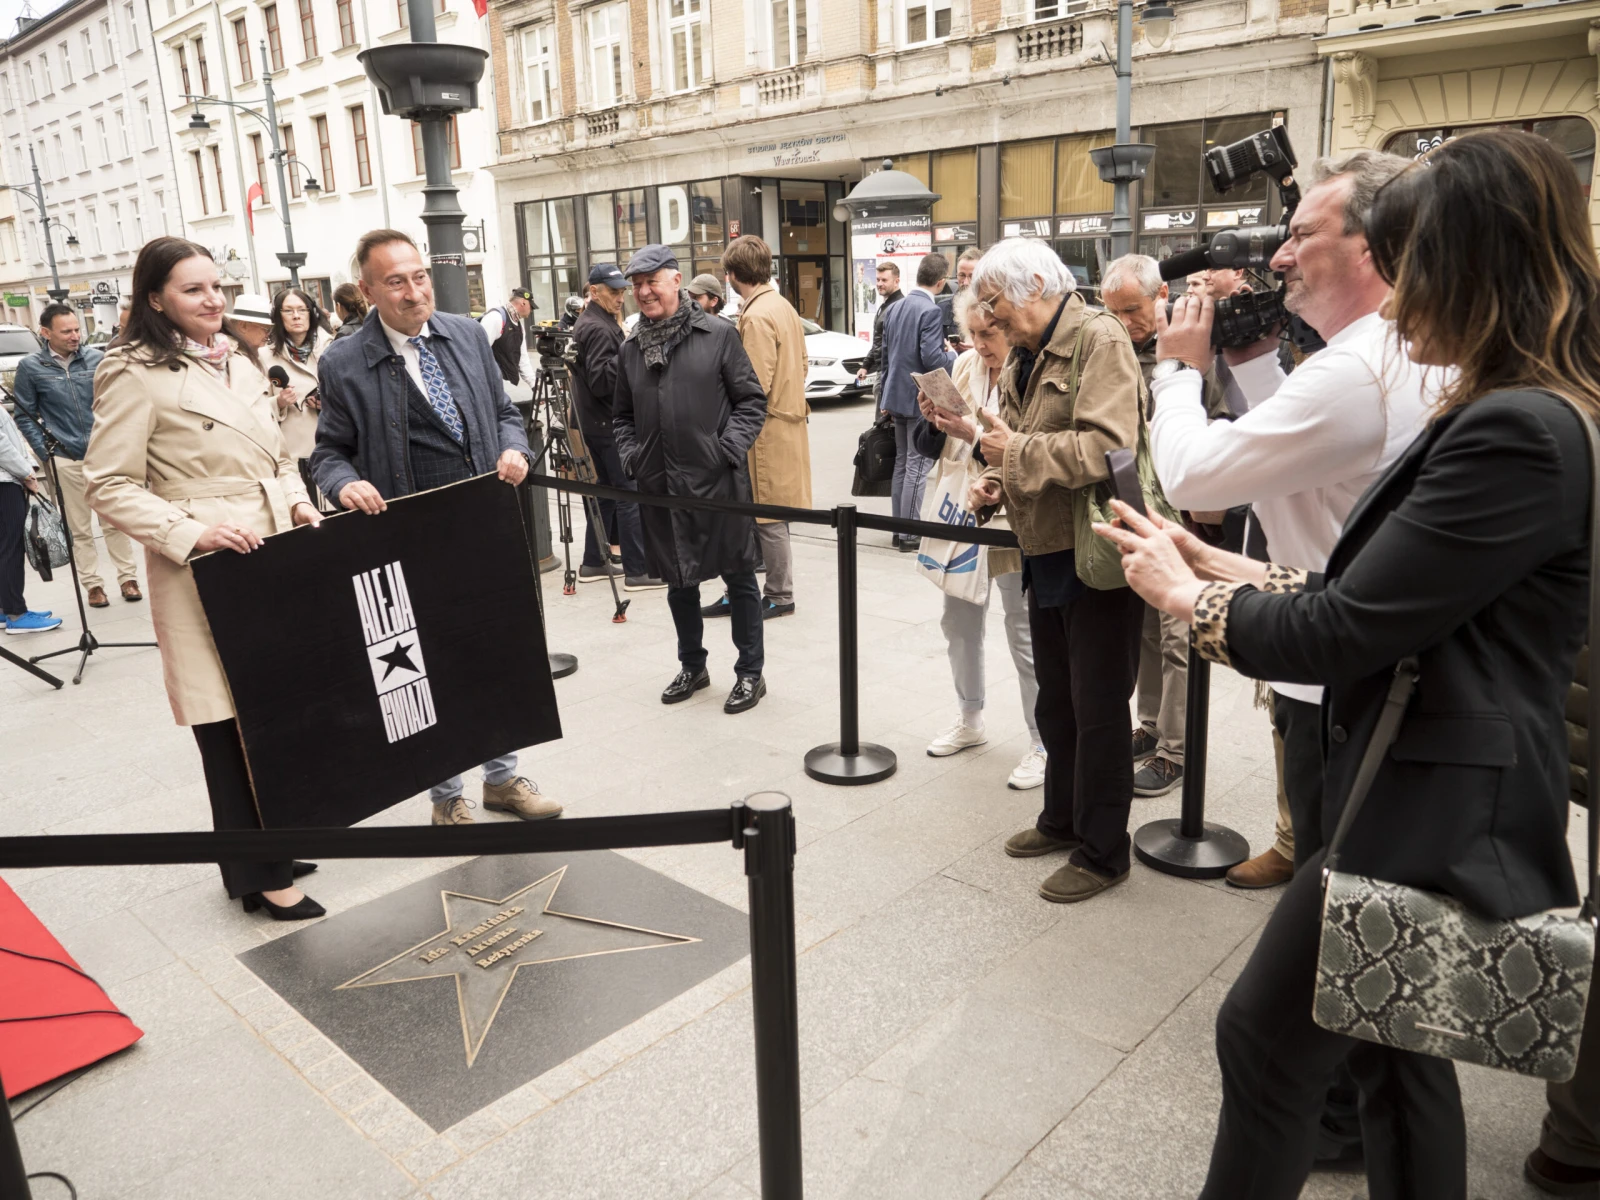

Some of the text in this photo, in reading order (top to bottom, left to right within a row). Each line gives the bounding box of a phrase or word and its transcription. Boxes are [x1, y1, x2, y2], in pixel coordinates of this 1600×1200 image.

[747, 133, 846, 154] STUDIUM JĘZYKÓW OBCYCH
[98, 283, 108, 291] 64
[352, 560, 417, 646] ALEJA
[379, 677, 437, 743] GWIAZD
[419, 947, 450, 963] Ida
[466, 927, 517, 957] Aktorka
[475, 929, 543, 969] Reżyserka
